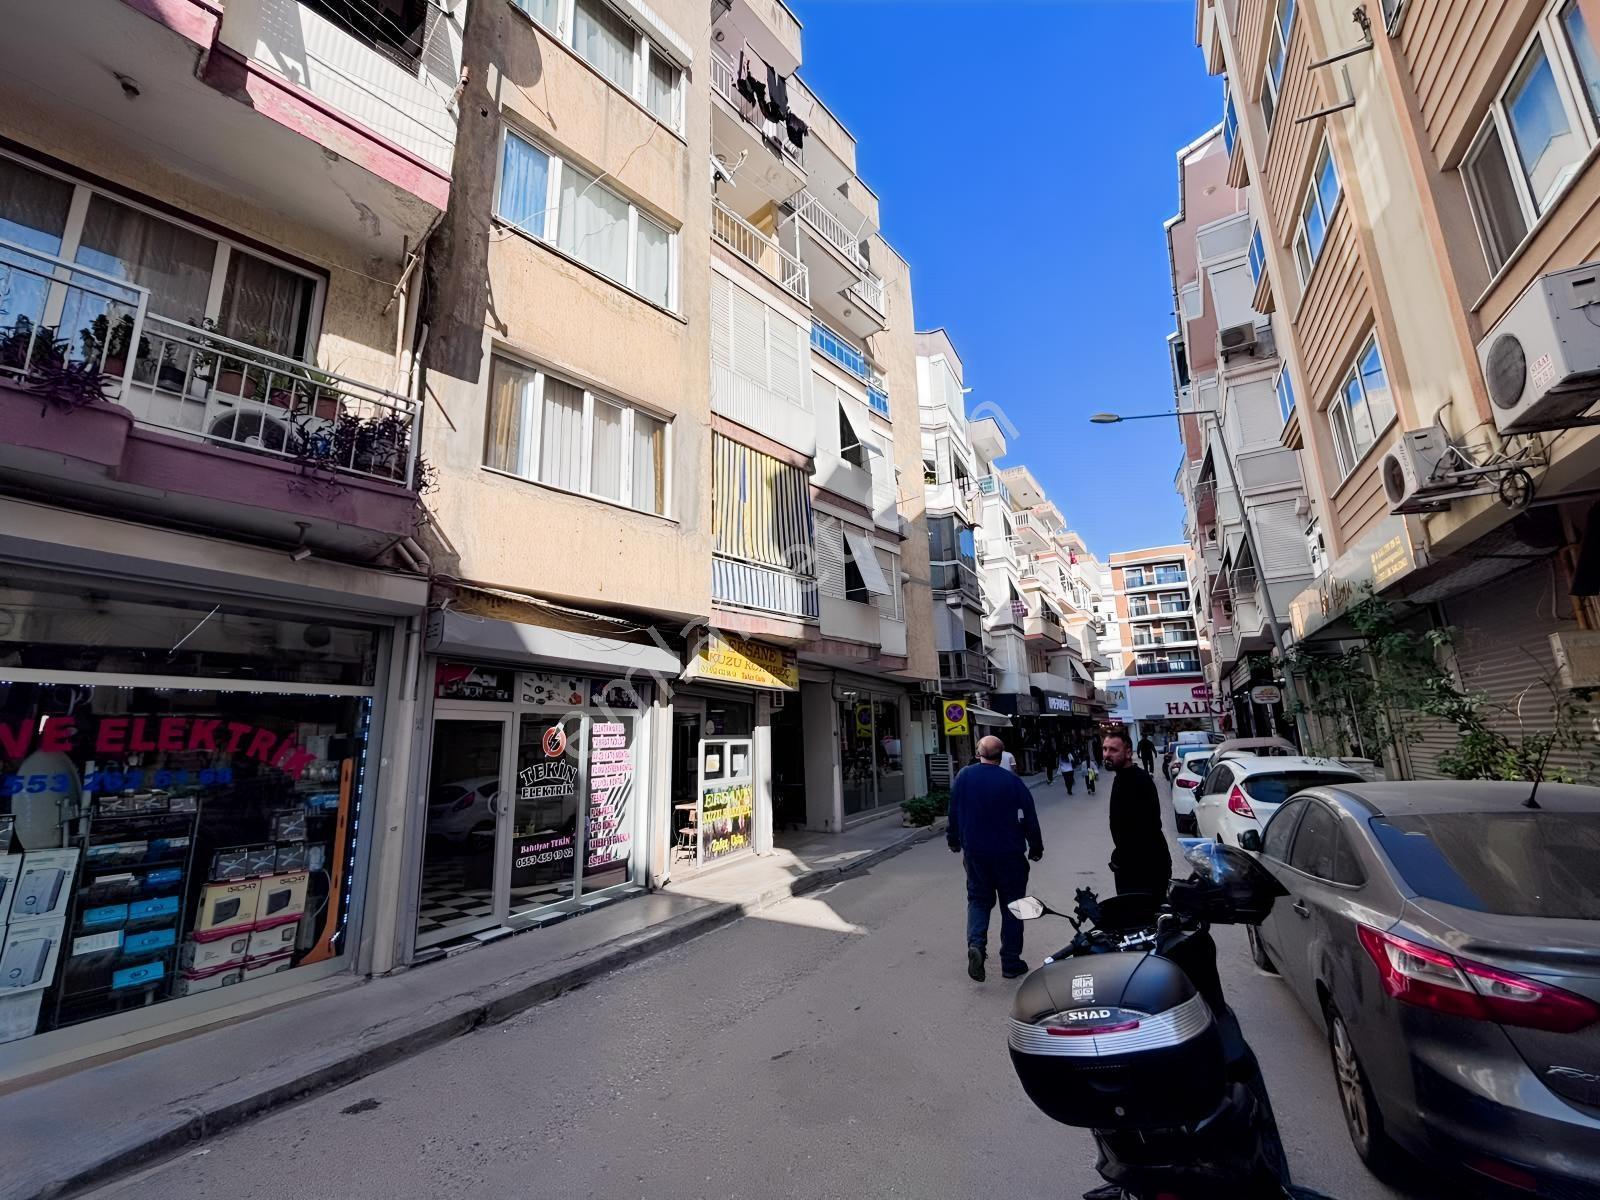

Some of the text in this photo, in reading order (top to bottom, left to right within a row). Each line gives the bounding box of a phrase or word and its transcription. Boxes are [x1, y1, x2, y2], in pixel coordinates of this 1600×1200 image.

[728, 639, 777, 663] EFSANE
[520, 759, 577, 787] TEKİN
[521, 782, 574, 799] ELEKTRİK
[1069, 1009, 1110, 1020] SHAD
